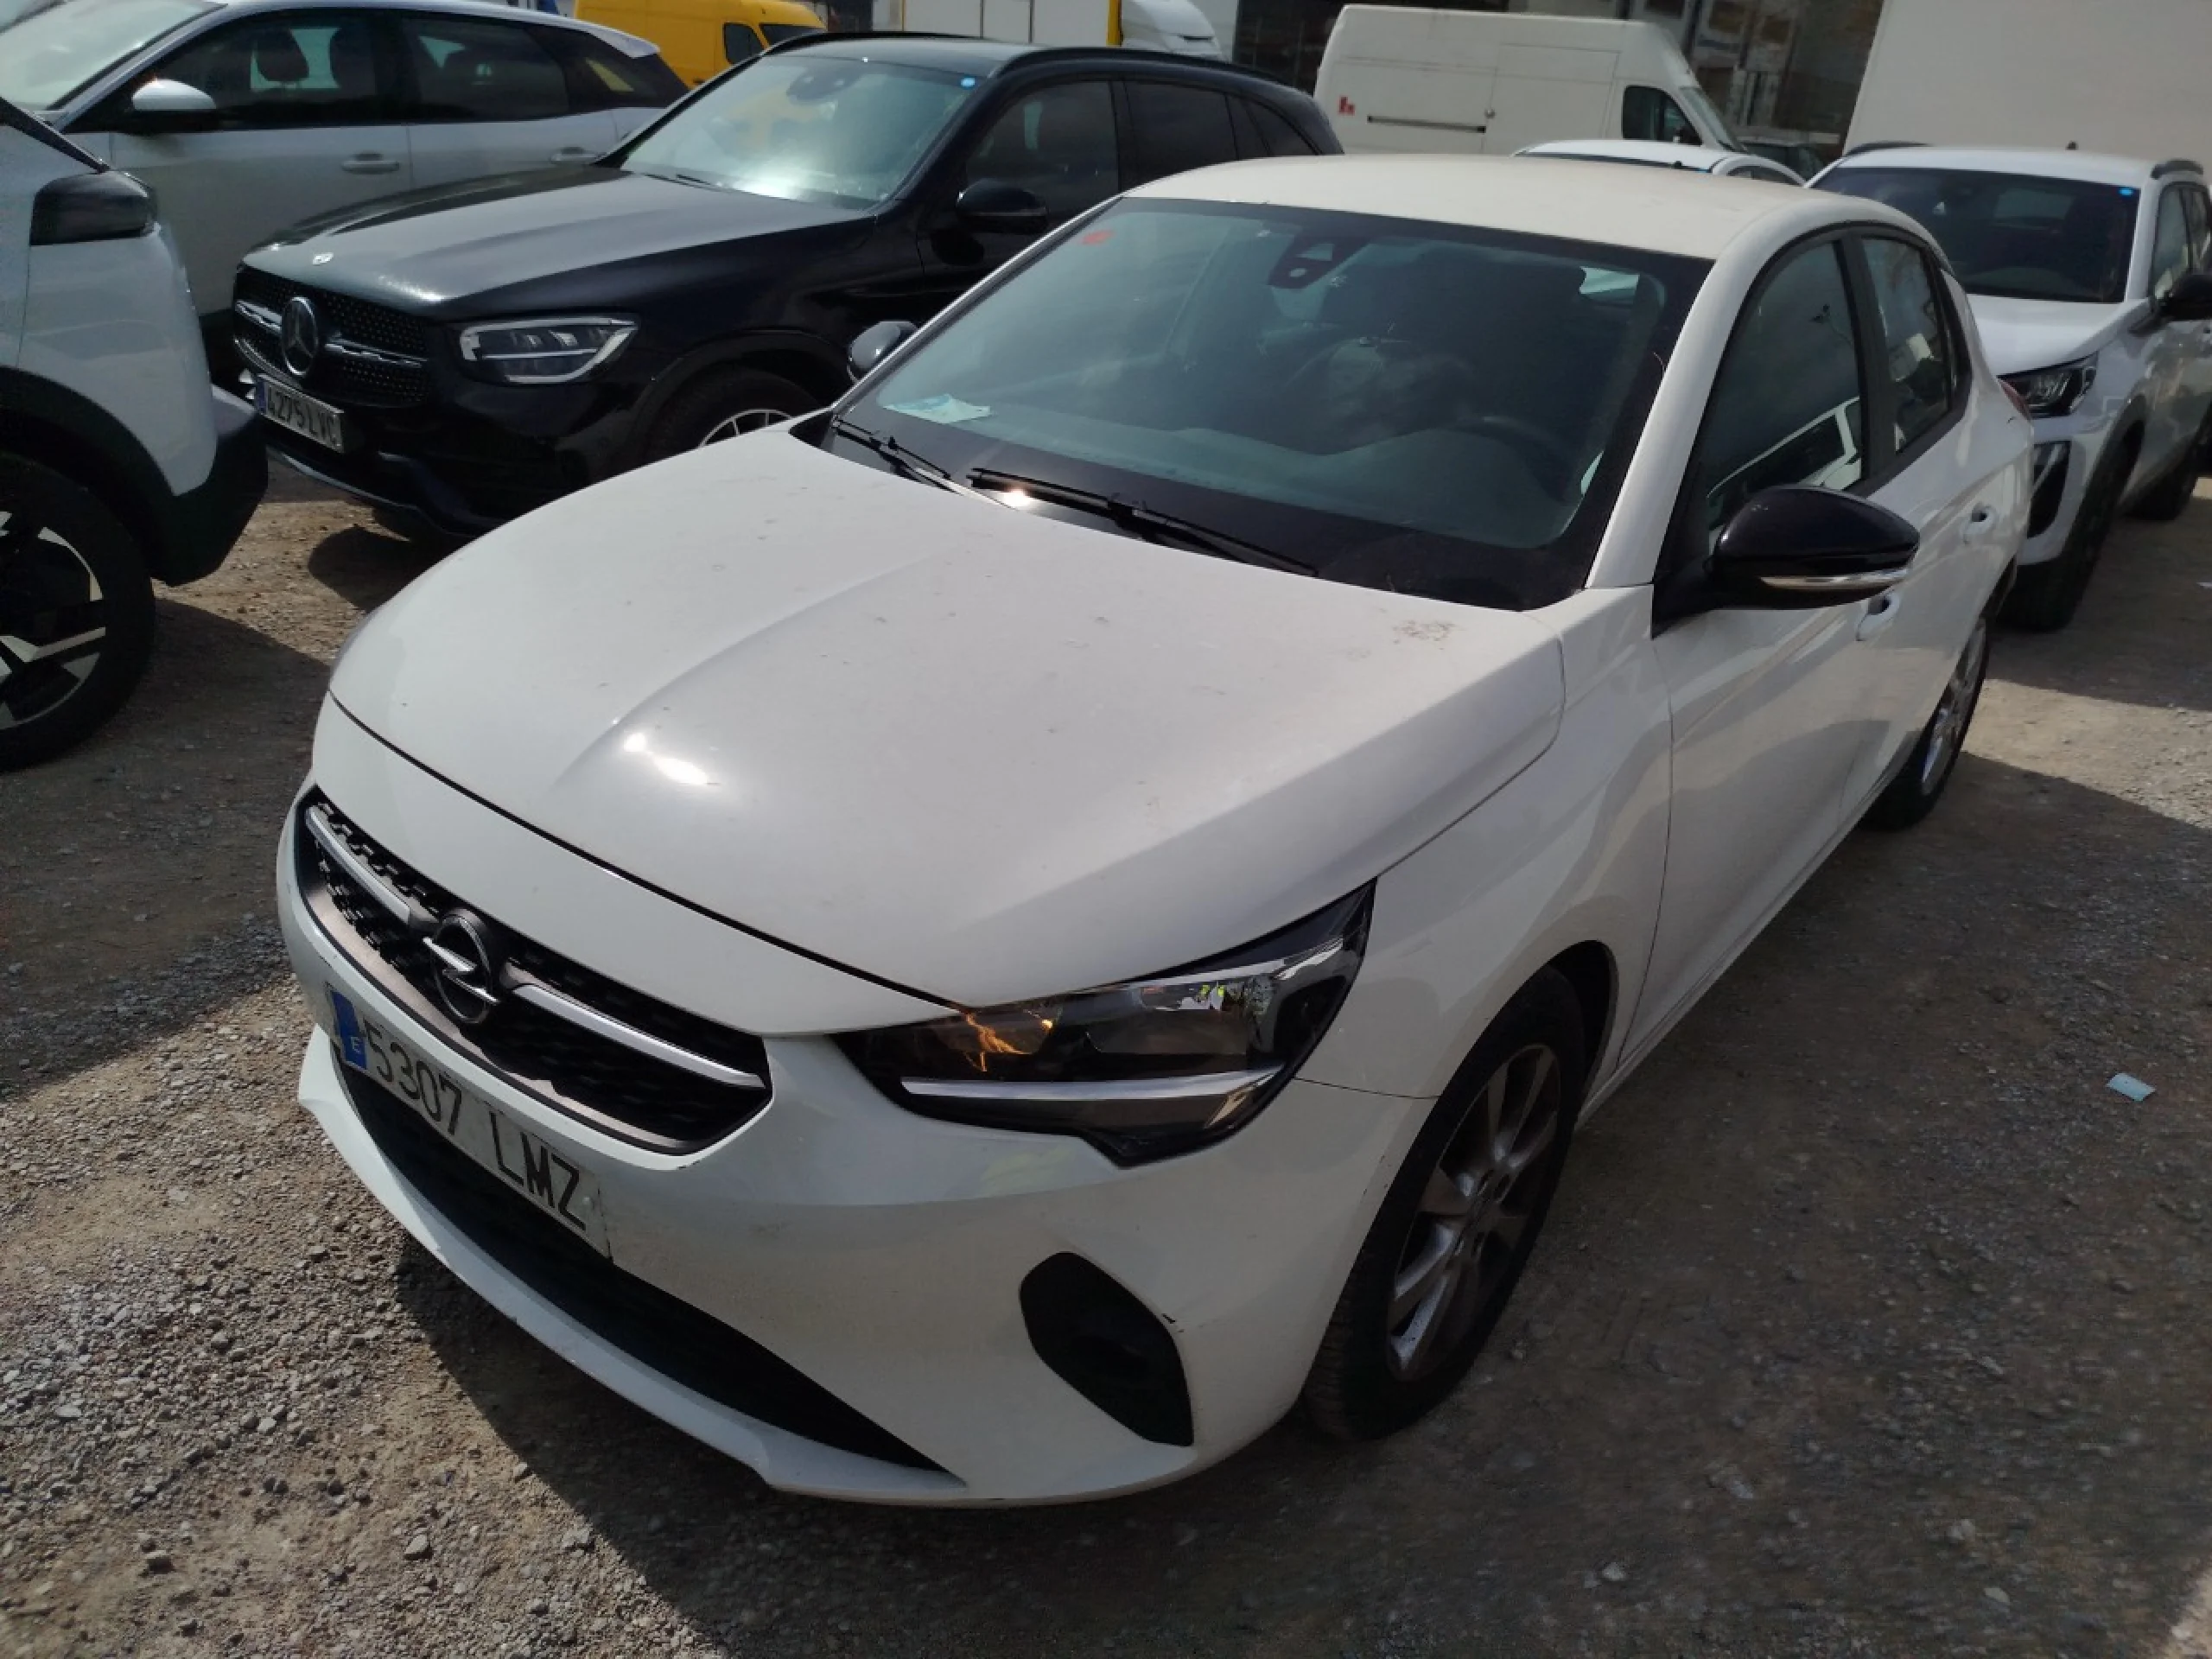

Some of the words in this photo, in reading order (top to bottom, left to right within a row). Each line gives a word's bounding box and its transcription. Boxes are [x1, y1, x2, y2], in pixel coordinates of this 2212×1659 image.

[350, 1036, 360, 1053] E
[363, 1020, 462, 1136] 5307
[489, 1110, 587, 1231] LMZ
